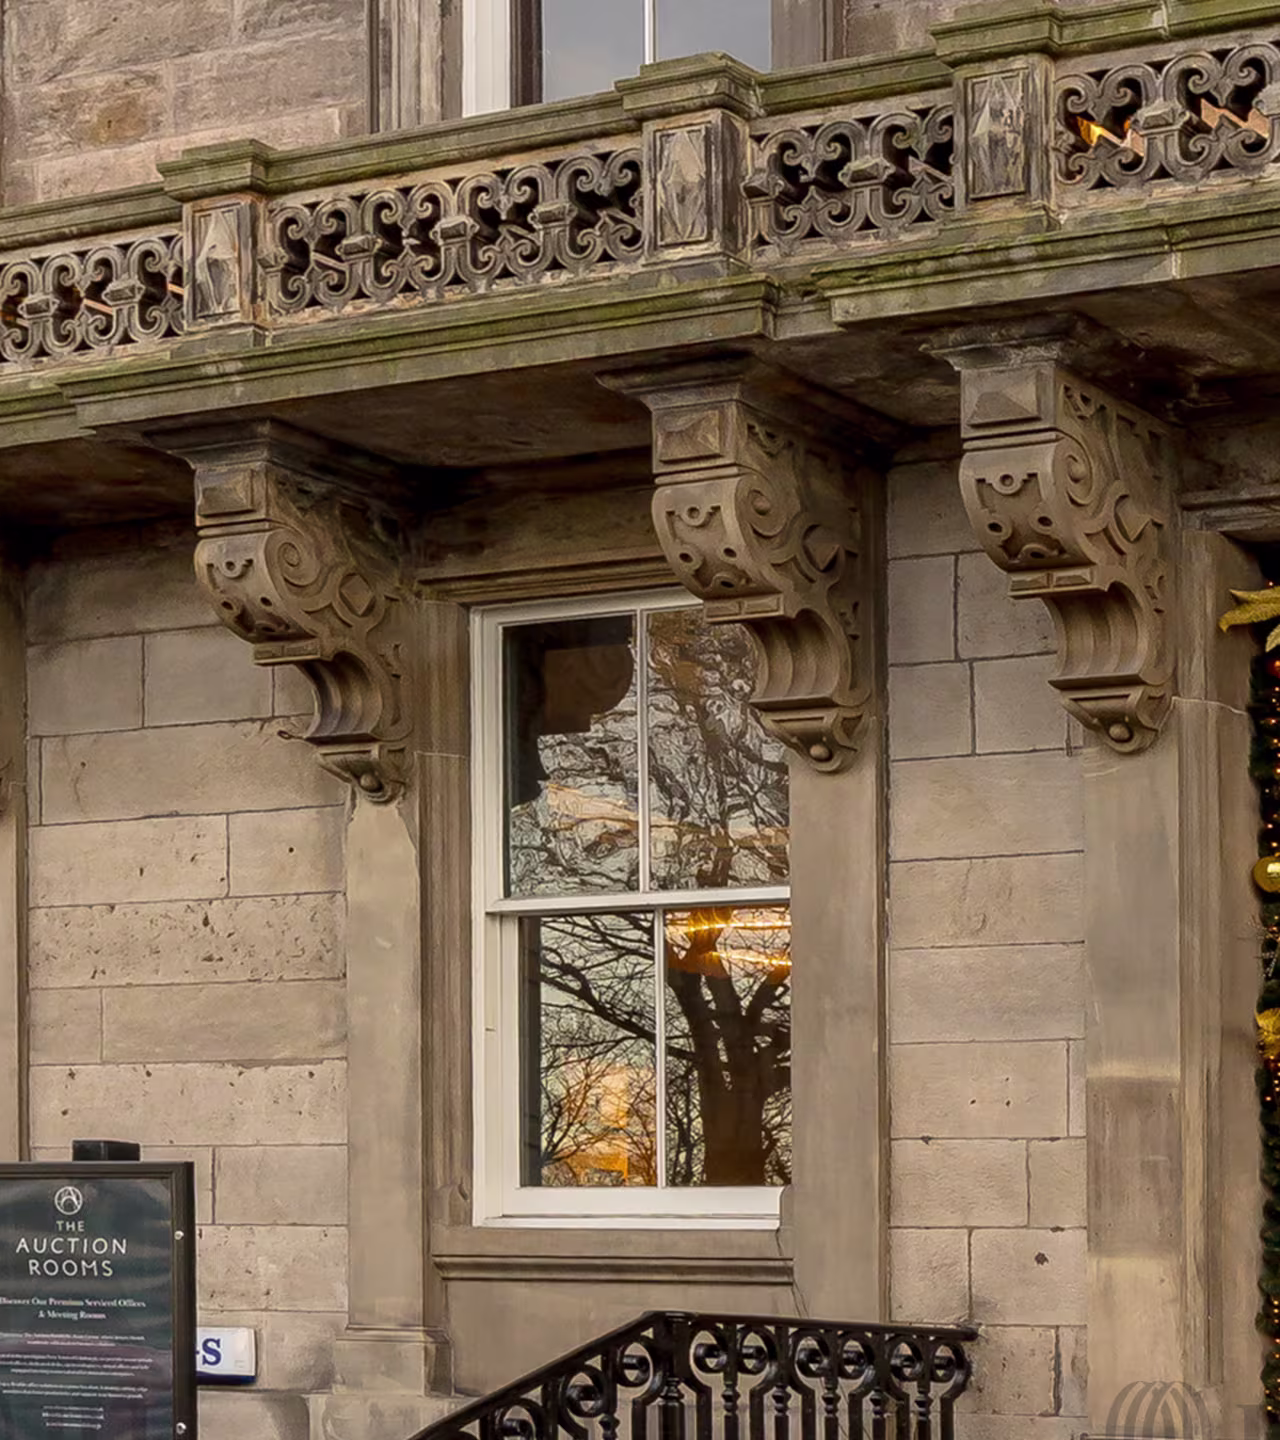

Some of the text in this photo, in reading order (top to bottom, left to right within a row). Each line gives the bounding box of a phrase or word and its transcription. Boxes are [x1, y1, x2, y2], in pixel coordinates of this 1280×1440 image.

[56, 1220, 85, 1232] THE
[15, 1237, 128, 1255] AUCTION
[28, 1259, 114, 1277] ROOMS
